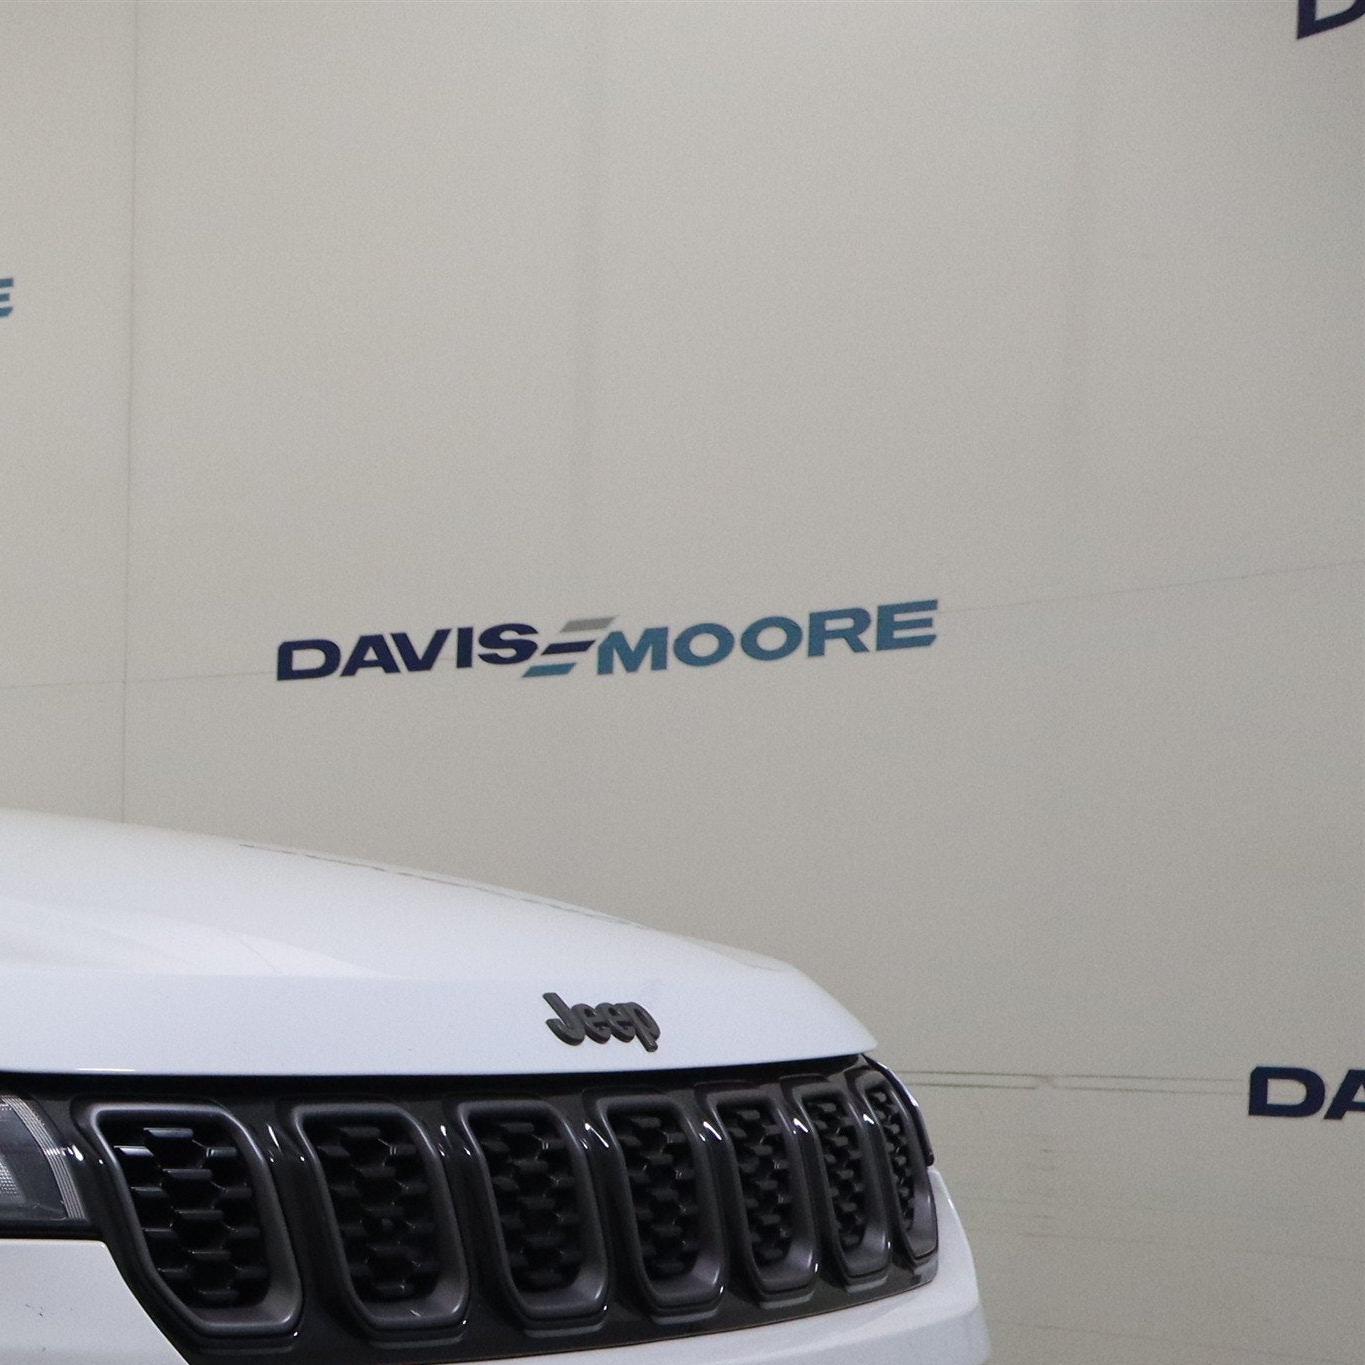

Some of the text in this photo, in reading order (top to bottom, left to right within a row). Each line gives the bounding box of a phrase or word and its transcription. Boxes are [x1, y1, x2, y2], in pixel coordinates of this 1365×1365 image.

[276, 599, 938, 681] DAVIS MOORE
[542, 992, 661, 1053] Jeep
